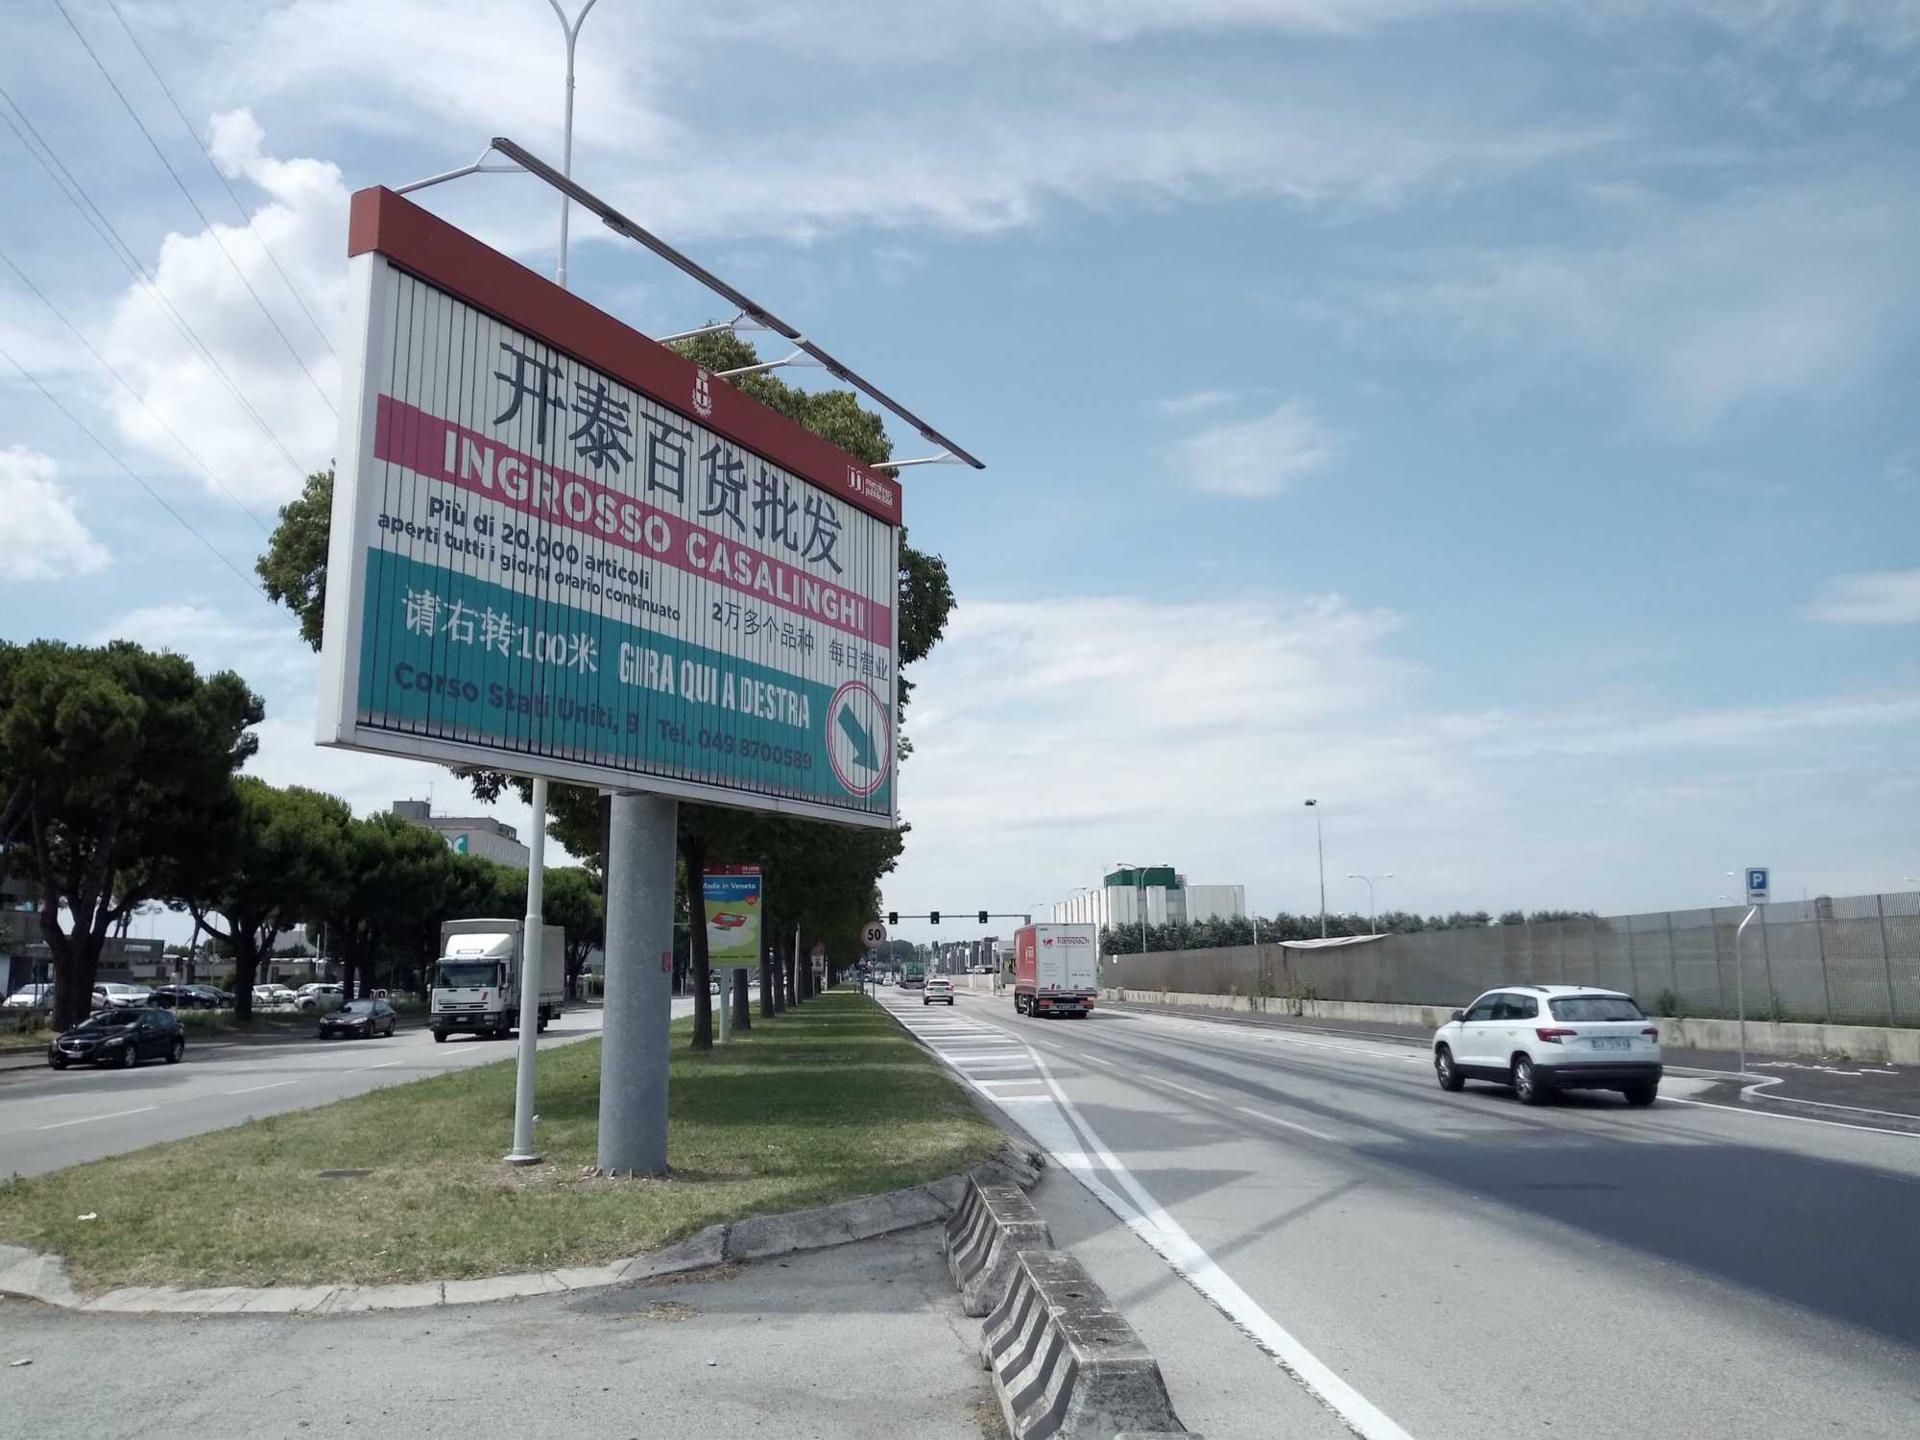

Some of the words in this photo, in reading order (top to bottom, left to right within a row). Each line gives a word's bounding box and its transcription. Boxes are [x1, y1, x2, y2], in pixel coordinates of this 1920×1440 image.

[493, 342, 843, 574] 开泰百货批发
[378, 513, 439, 544] aperti
[444, 531, 485, 560] tutti
[490, 546, 496, 562] i
[500, 553, 549, 582] giorni
[555, 572, 601, 595] orario
[606, 587, 681, 621] continuato
[429, 496, 466, 526] Più
[473, 514, 495, 537] di
[501, 522, 579, 564] 20.000
[585, 555, 649, 590] articoli
[444, 430, 671, 552] INGROSSO
[685, 532, 864, 630] CASALINGHI
[401, 584, 598, 675] 请右转100米
[712, 602, 814, 656] 2万多个品种
[829, 638, 888, 681] 每日营业
[394, 661, 479, 703] Corso
[489, 682, 549, 719] Stati
[557, 695, 619, 735] Uniti,
[659, 719, 691, 747] Tel.
[698, 728, 734, 755] 049
[619, 642, 675, 695] GIRA
[681, 659, 717, 704] QUI
[722, 672, 736, 712] A
[741, 676, 810, 729] DESTRA
[1752, 873, 1764, 887] P
[867, 929, 881, 941] 50
